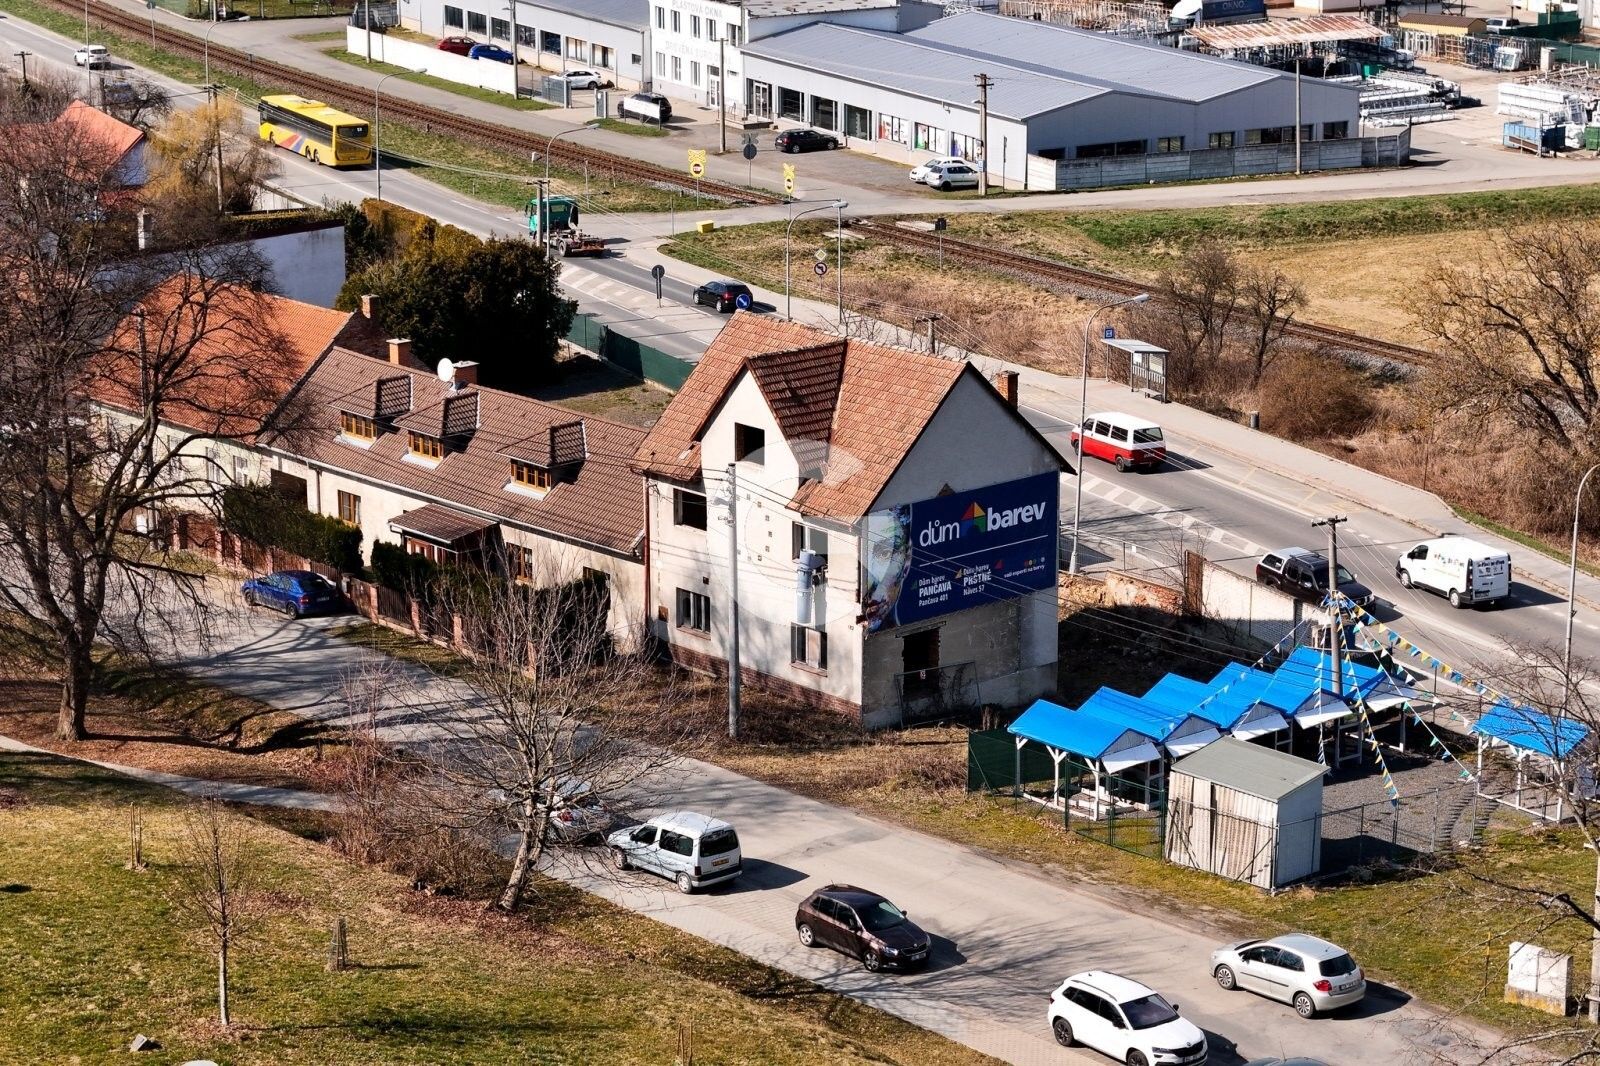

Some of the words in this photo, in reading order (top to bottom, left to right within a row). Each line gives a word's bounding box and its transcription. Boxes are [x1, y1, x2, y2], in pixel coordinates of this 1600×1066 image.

[919, 519, 960, 547] dům
[987, 501, 1046, 531] barev
[918, 581, 952, 598] PANČAVA
[918, 596, 939, 607] Pančava
